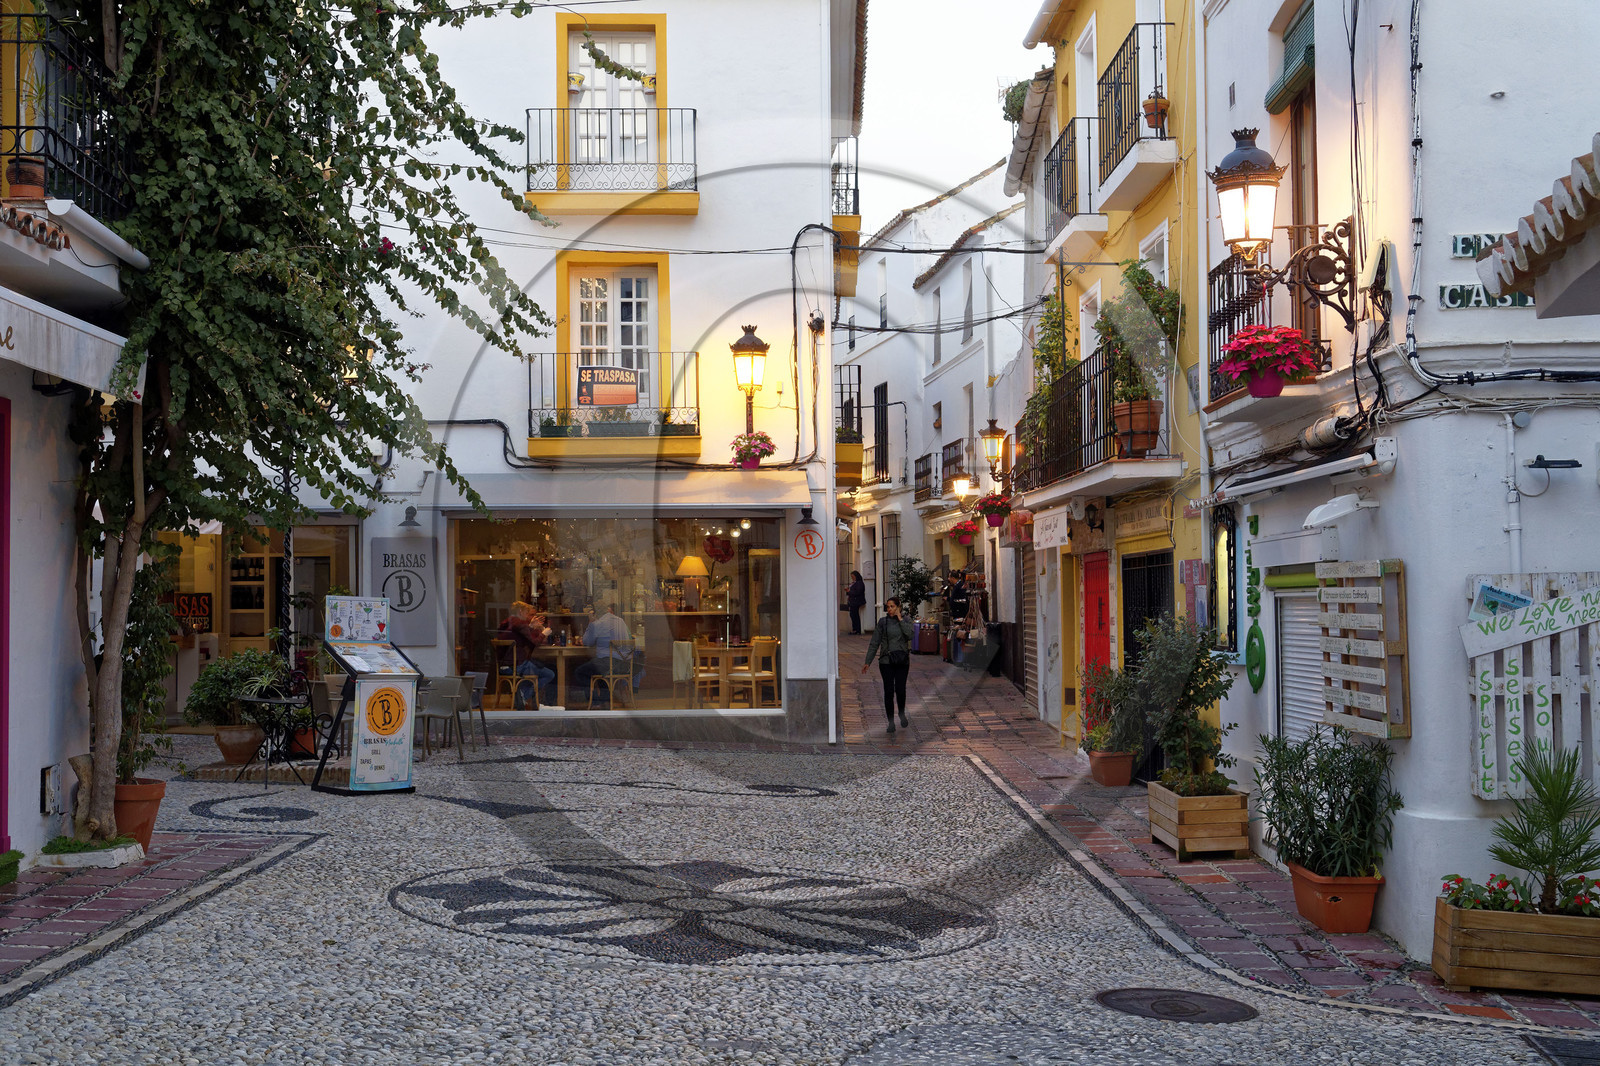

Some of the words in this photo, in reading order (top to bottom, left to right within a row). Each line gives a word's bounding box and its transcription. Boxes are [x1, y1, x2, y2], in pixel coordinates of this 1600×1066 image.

[581, 369, 592, 382] SE
[593, 369, 636, 383] TRASPASA
[801, 533, 816, 556] B
[382, 553, 427, 568] BRASAS
[395, 575, 414, 607] B
[379, 699, 392, 726] B
